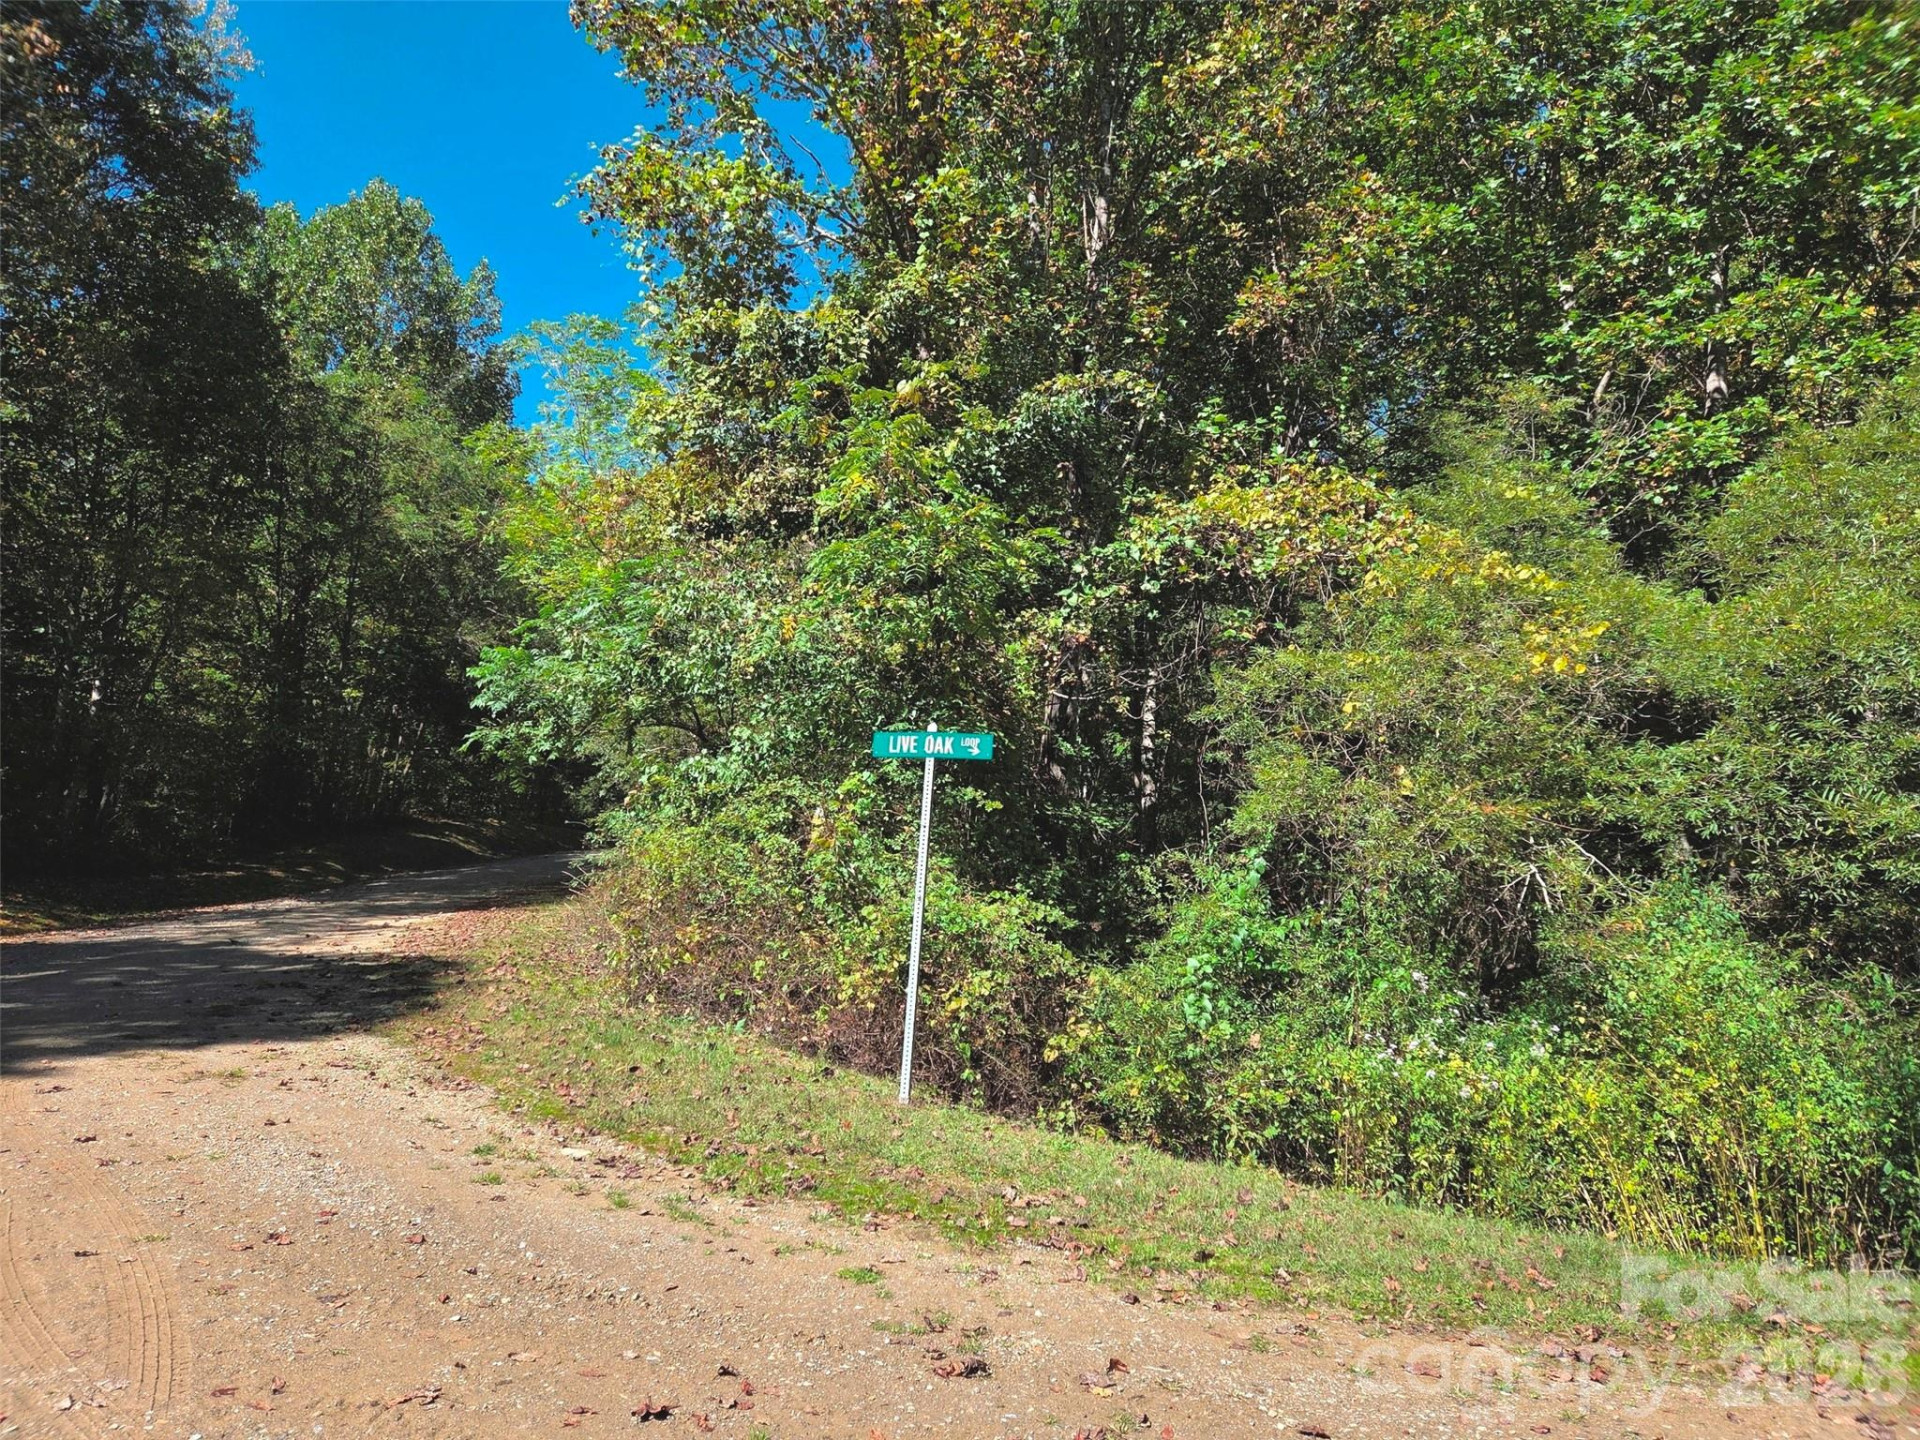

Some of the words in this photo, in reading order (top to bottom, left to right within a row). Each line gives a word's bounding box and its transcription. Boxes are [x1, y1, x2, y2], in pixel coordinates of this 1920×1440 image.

[889, 735, 918, 753] LIVE
[924, 735, 954, 754] OAK
[961, 737, 980, 748] LOOP
